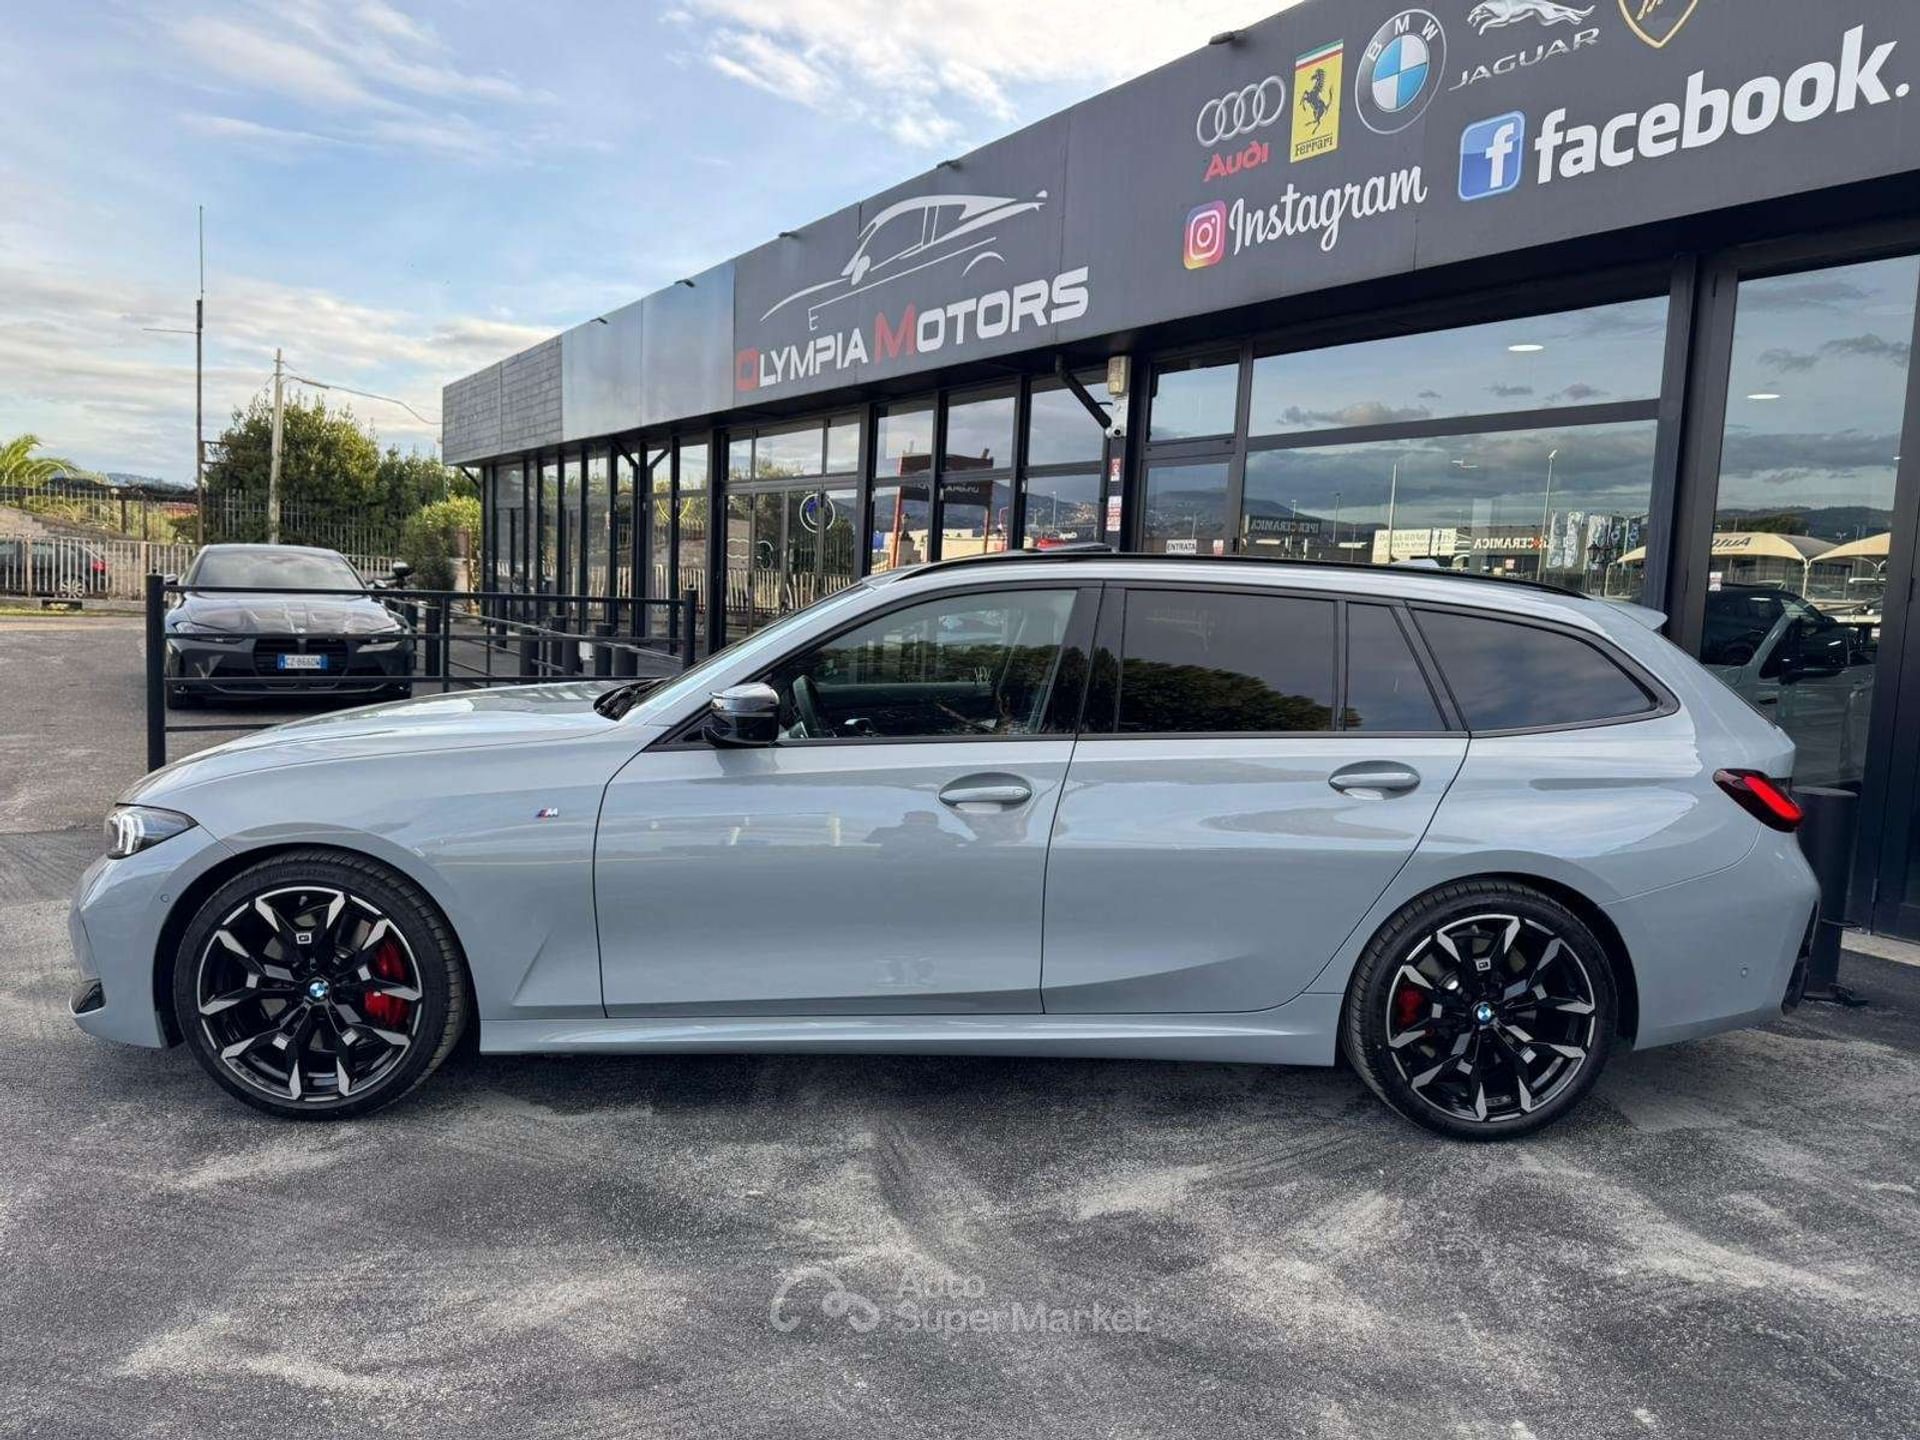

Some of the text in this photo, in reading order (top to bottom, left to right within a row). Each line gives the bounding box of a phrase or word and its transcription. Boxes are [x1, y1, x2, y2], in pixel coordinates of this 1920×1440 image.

[1448, 27, 1600, 92] JAGUAR
[1535, 22, 1912, 186] facebook.
[1294, 133, 1334, 157] Ferrari
[1229, 165, 1428, 256] Instagram
[1167, 541, 1196, 552] ENTRATA
